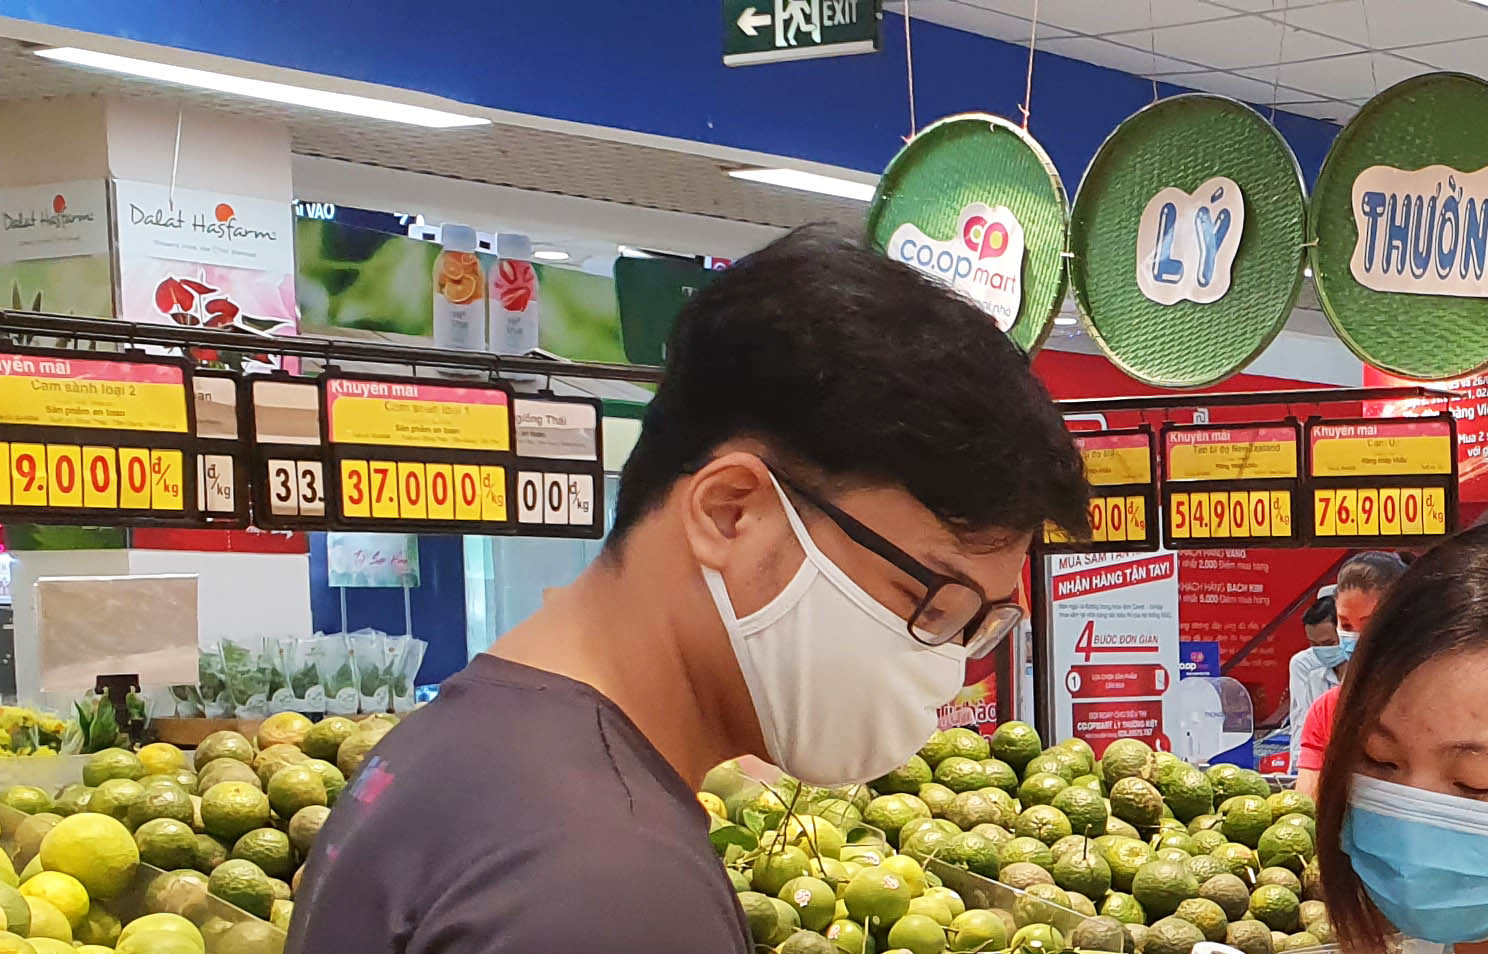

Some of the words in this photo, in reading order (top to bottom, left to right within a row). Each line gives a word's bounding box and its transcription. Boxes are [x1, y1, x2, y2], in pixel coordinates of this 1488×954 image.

[823, 1, 858, 26] EXIT
[129, 202, 185, 229] Dalat
[192, 212, 277, 241] Hasfarm
[1153, 186, 1231, 288] LÝ
[129, 385, 137, 396] 2
[1478, 431, 1485, 442] 2
[347, 467, 478, 507] 37.000
[1174, 498, 1267, 529] 54.900
[1318, 494, 1418, 527] 76.900
[1057, 579, 1091, 597] NHẬN
[1092, 570, 1123, 589] HÀNG
[1124, 565, 1147, 584] TẬN
[1149, 561, 1171, 577] TAY!
[1058, 557, 1083, 571] MUA
[1075, 620, 1095, 662] 4
